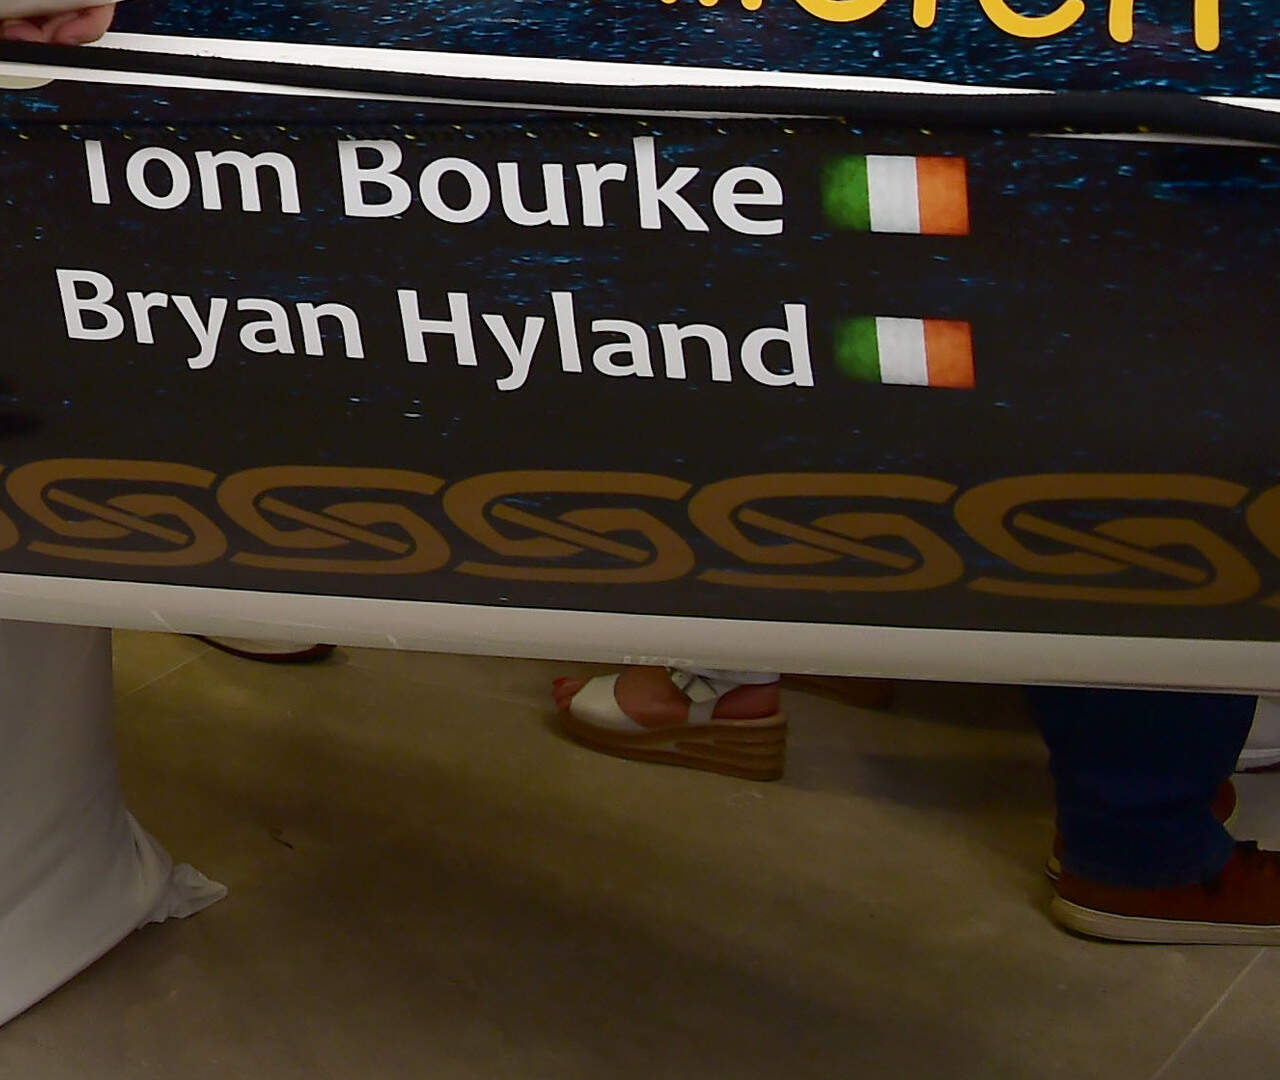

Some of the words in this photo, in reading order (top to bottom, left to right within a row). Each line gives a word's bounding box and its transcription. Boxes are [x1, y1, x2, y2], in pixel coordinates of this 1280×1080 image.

[337, 136, 784, 235] Bourke
[54, 268, 365, 370] Bryan
[397, 289, 815, 391] Hyland
